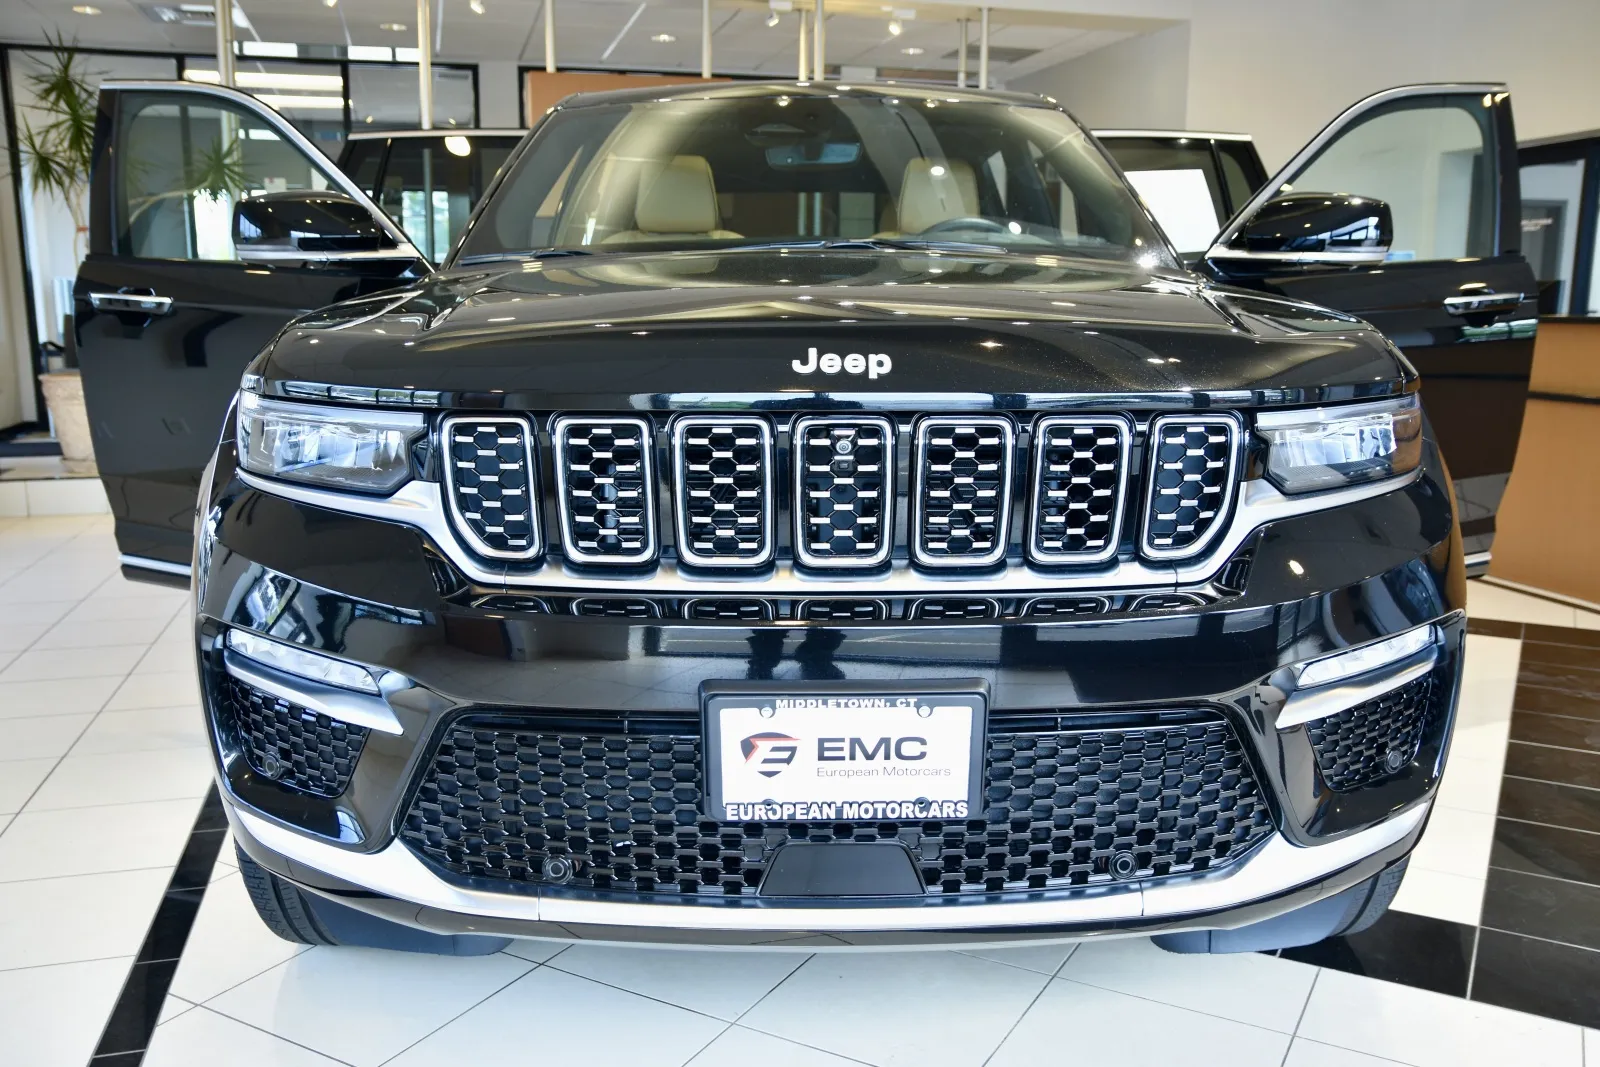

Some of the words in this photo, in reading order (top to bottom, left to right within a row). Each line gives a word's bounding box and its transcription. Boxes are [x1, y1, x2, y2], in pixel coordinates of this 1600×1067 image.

[792, 347, 893, 380] Jeep
[775, 698, 891, 709] MIDDLETOWN,
[896, 698, 918, 708] CT
[817, 736, 928, 762] EMC
[816, 766, 879, 779] European
[882, 765, 951, 777] Motorcars
[726, 803, 836, 821] EUROPEAN
[842, 801, 969, 820] MOTORCARS
